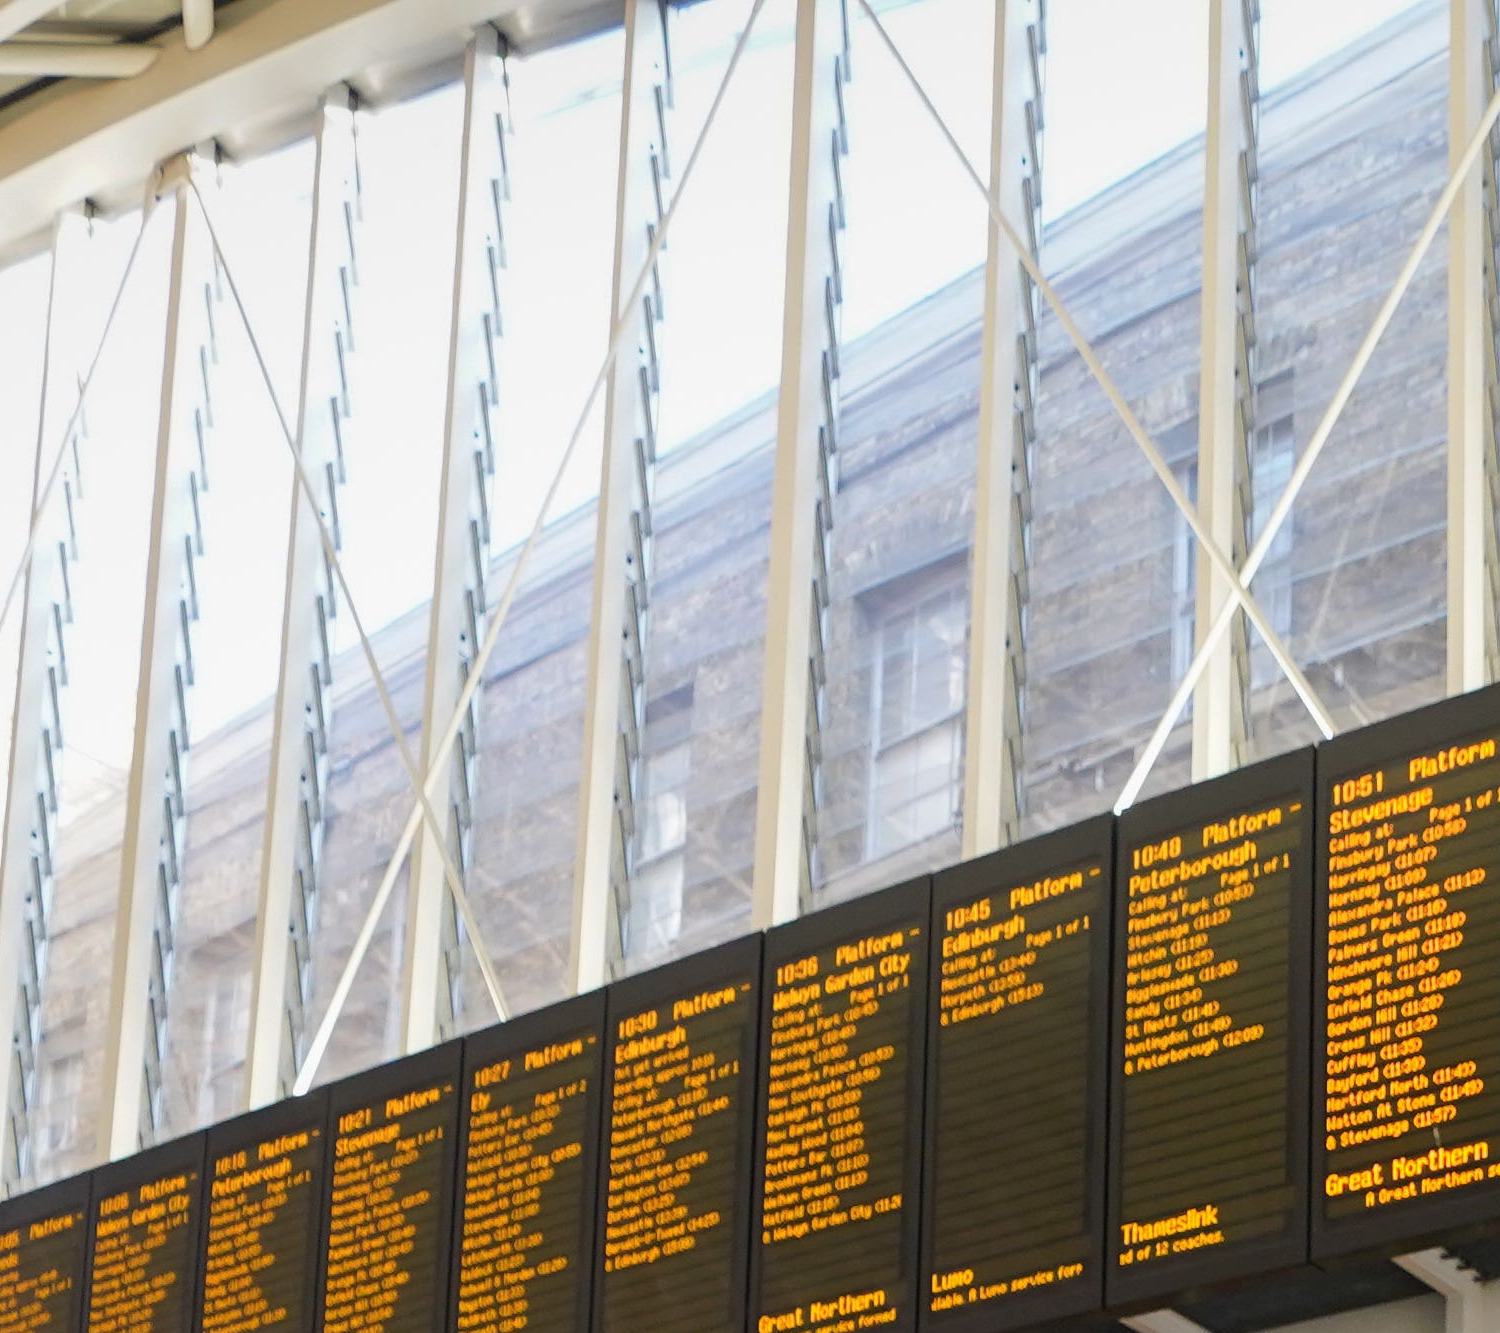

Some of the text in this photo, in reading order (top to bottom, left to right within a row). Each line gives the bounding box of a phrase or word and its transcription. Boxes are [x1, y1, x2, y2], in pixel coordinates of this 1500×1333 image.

[1333, 739, 1495, 805] 10:51 Platform
[1202, 807, 1281, 847] Platform
[1329, 786, 1433, 834] Stevenage
[1129, 840, 1256, 896] Peterborough
[1009, 871, 1082, 909] Platform
[835, 931, 903, 966] Platform
[942, 914, 1024, 957] Edinburgh
[879, 953, 909, 976] City
[615, 1025, 686, 1064] Edinburgh
[1325, 1141, 1488, 1196] Great Northern
[1121, 1204, 1217, 1245] Thameslink
[931, 1269, 973, 1292] Lumo
[810, 1290, 885, 1322] Northern
